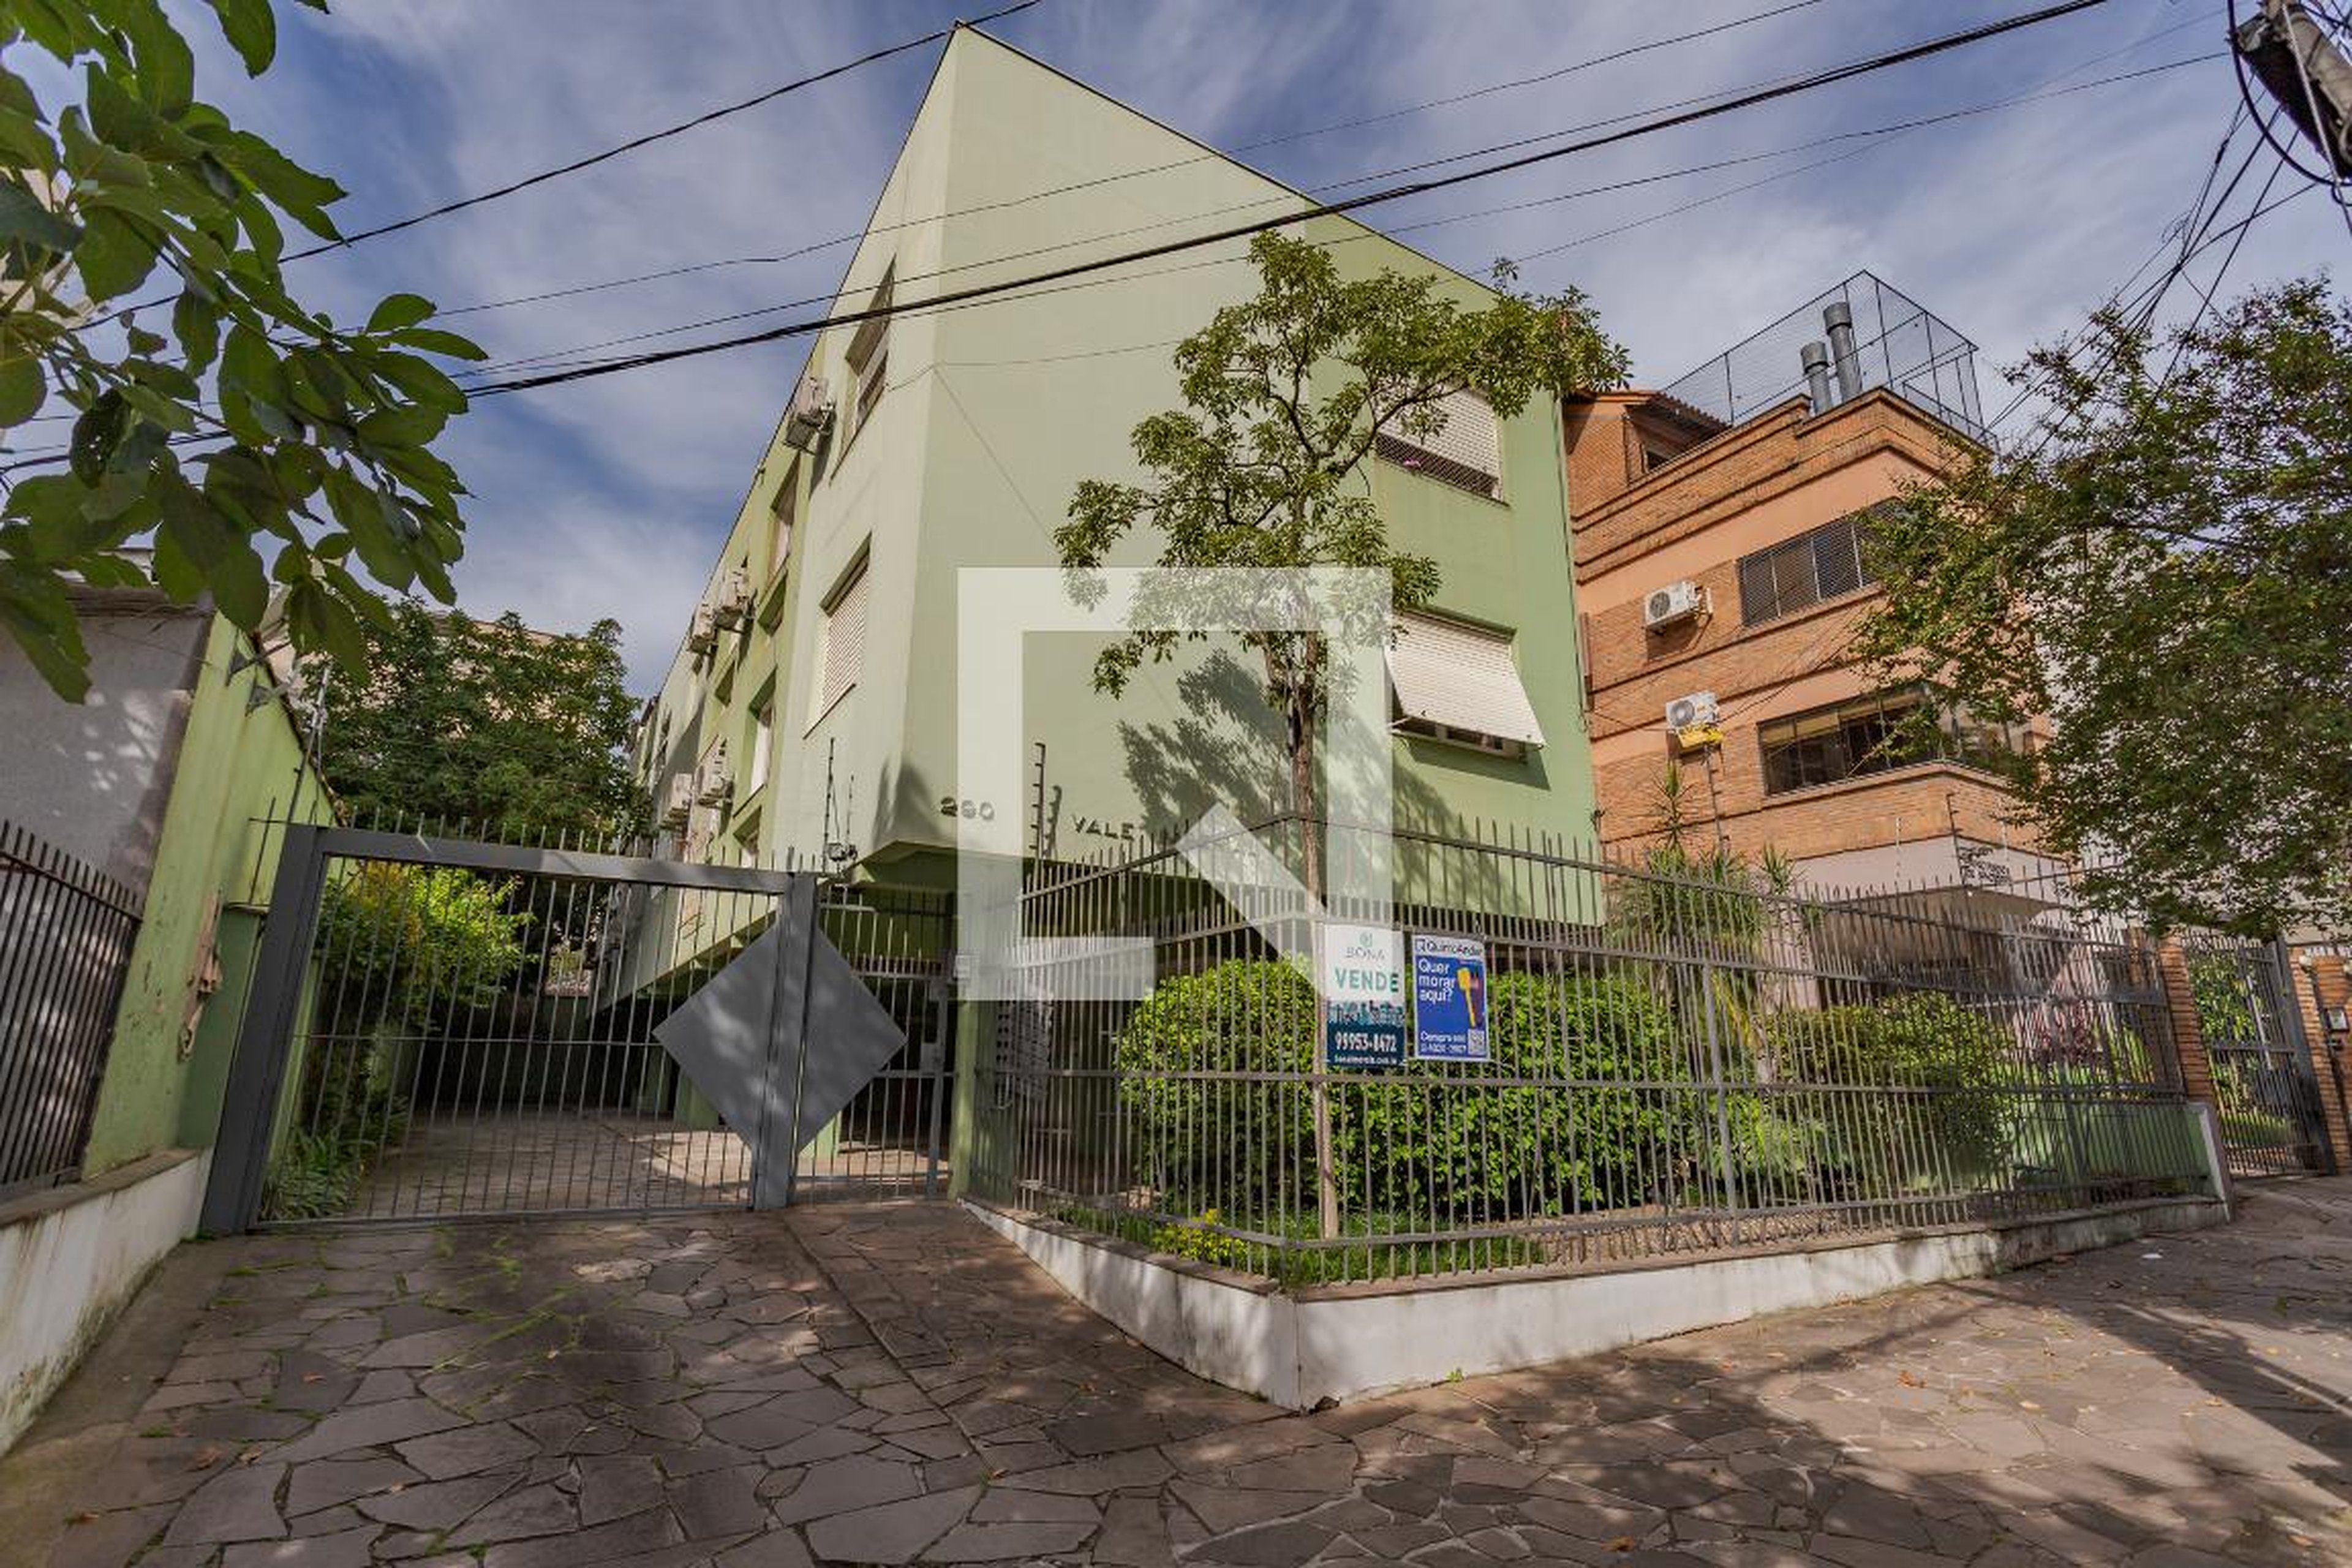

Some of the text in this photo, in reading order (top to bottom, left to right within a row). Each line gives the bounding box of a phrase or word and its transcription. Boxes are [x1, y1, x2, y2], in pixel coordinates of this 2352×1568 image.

[1419, 958, 1450, 974] Quer
[1335, 967, 1400, 993] VENDE
[1419, 975, 1456, 989] morar
[1419, 987, 1453, 1005] aqui?
